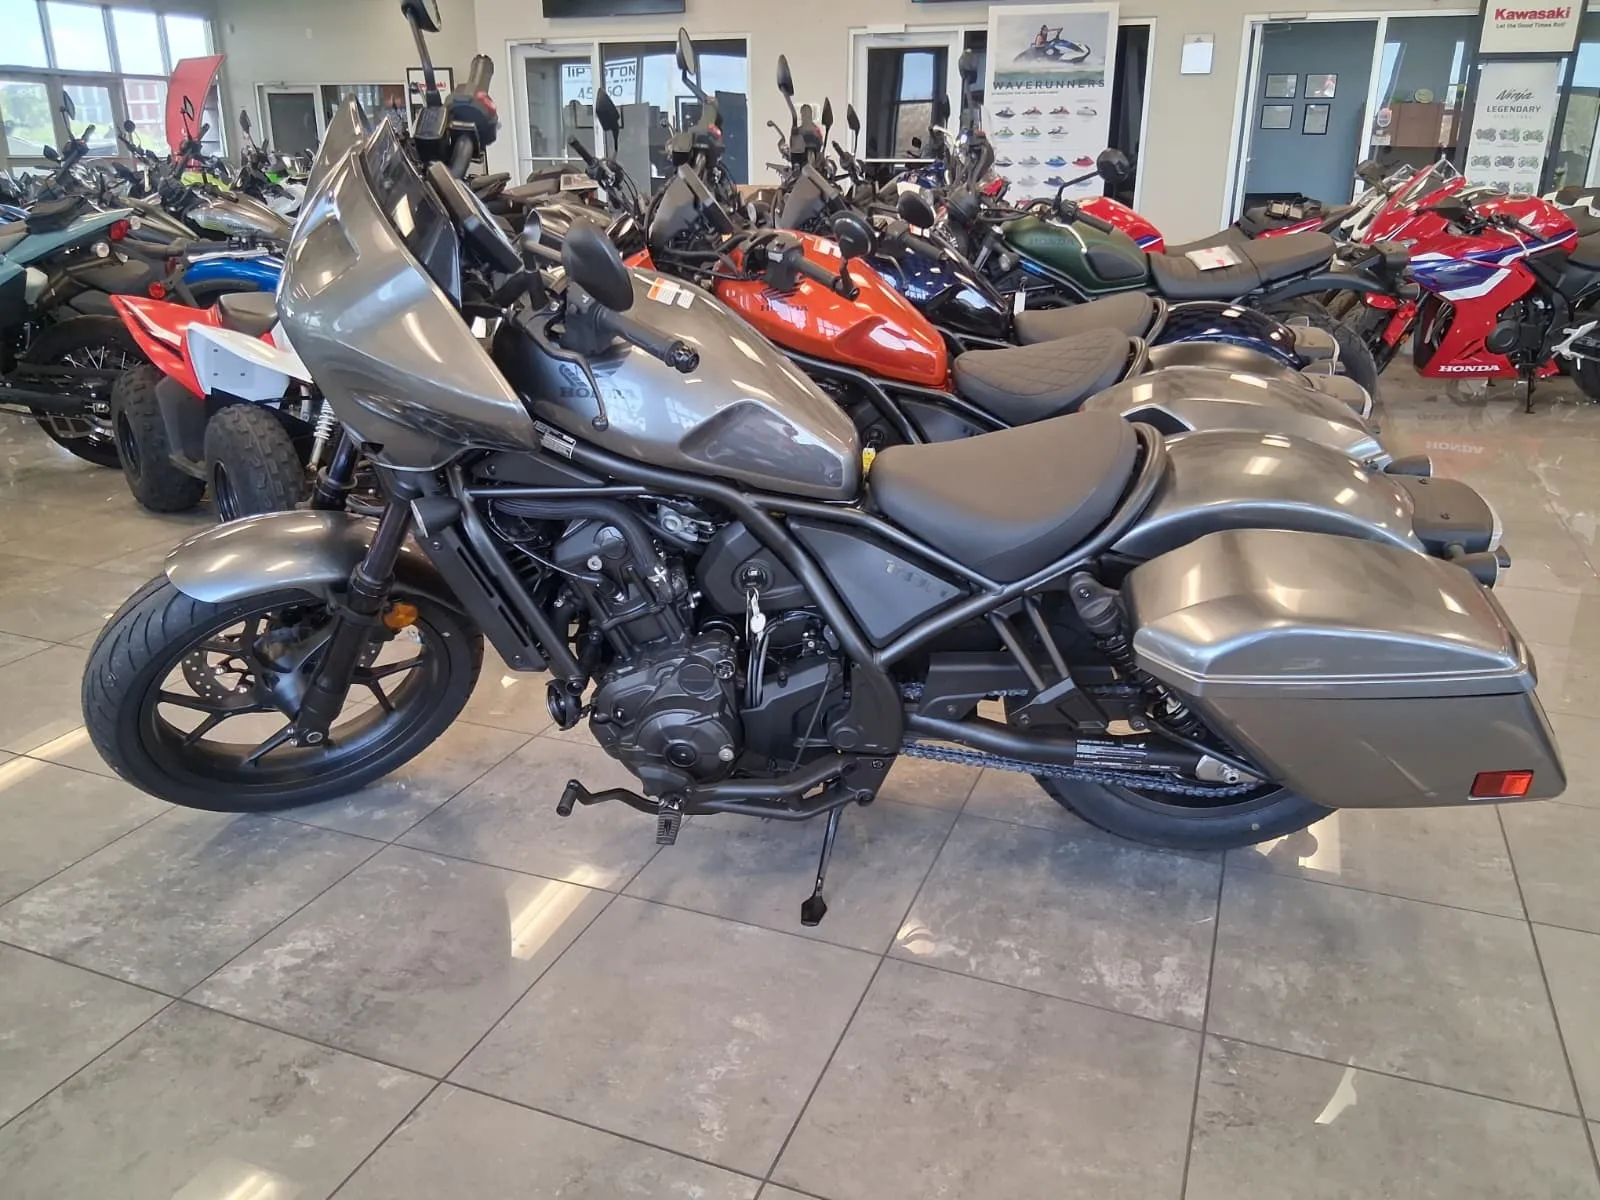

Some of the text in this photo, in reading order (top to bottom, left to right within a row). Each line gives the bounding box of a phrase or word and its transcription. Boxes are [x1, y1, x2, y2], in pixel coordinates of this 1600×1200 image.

[1494, 6, 1571, 20] Kawasaki
[992, 79, 1105, 90] WAVERUNNERS
[1495, 88, 1534, 102] Ninja
[1486, 105, 1541, 113] LEGENDARY
